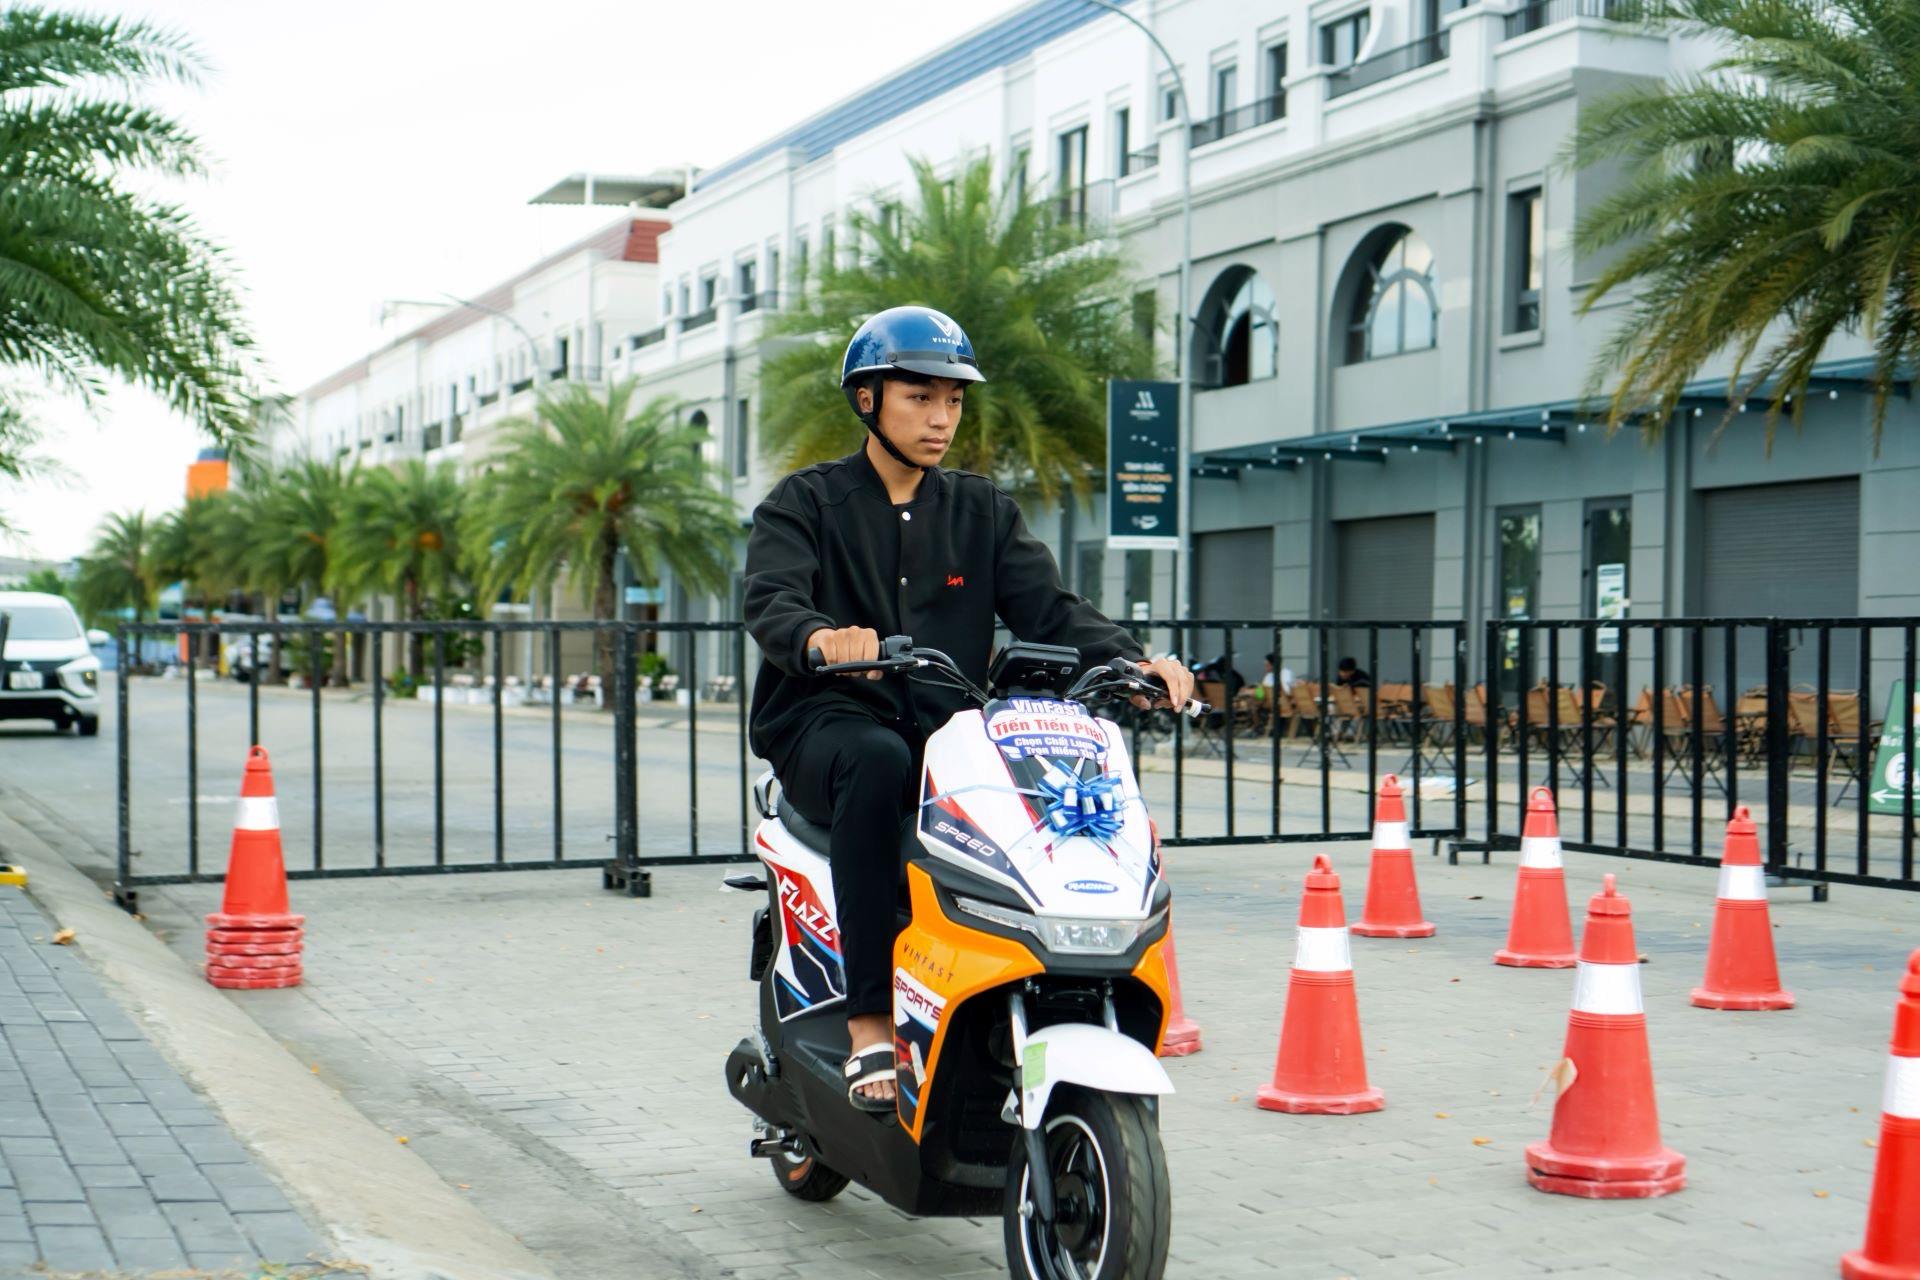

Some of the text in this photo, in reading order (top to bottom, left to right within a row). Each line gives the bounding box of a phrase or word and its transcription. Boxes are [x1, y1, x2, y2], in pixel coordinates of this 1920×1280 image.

[1012, 699, 1080, 717] VinFast
[993, 718, 1030, 736] Tiến
[1034, 718, 1070, 732] Tiến
[934, 821, 997, 857] SPEED
[779, 874, 836, 941] FLAZZ
[903, 943, 954, 982] VINFAST
[895, 975, 943, 1020] SPORTS
